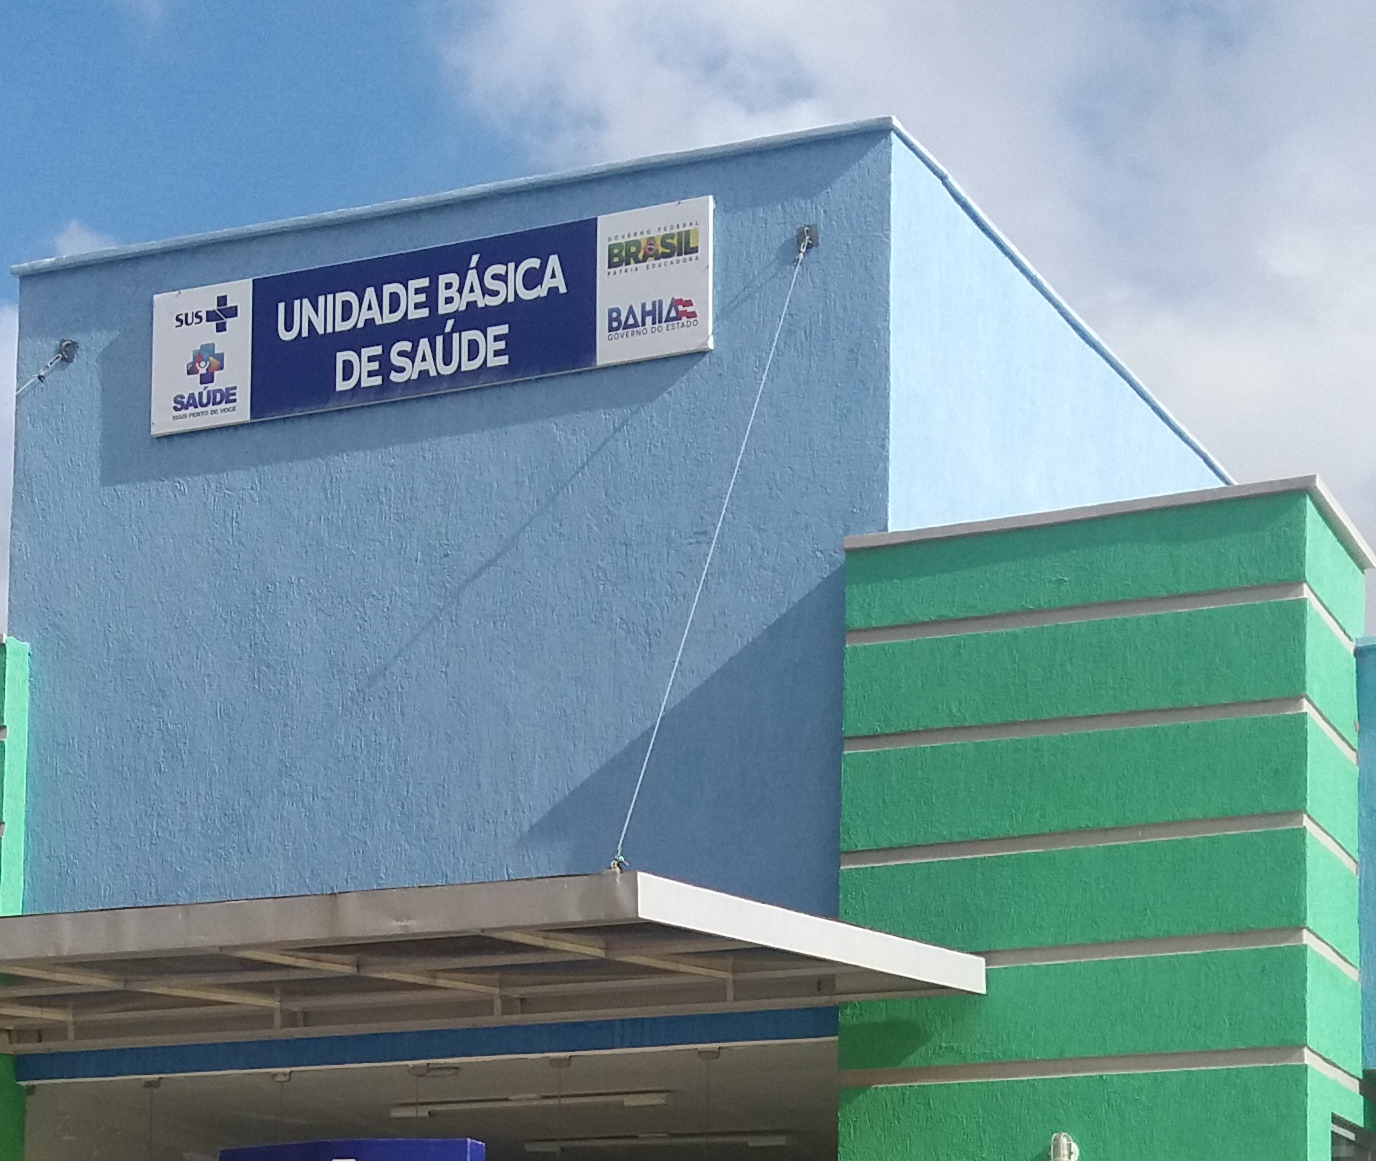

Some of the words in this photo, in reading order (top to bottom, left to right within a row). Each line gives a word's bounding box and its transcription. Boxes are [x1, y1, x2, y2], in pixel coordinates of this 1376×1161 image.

[607, 228, 700, 269] BRASIL
[277, 277, 430, 341] UNIDADE
[437, 253, 567, 315] BÁSICA
[607, 297, 683, 333] BAHIA
[174, 310, 203, 328] SUS
[607, 328, 648, 341] GOVERNO
[650, 325, 663, 333] DO
[666, 319, 699, 331] ESTADO
[335, 345, 383, 392] DE
[389, 319, 509, 383] SAÚDE
[172, 386, 237, 412] SAÚDE
